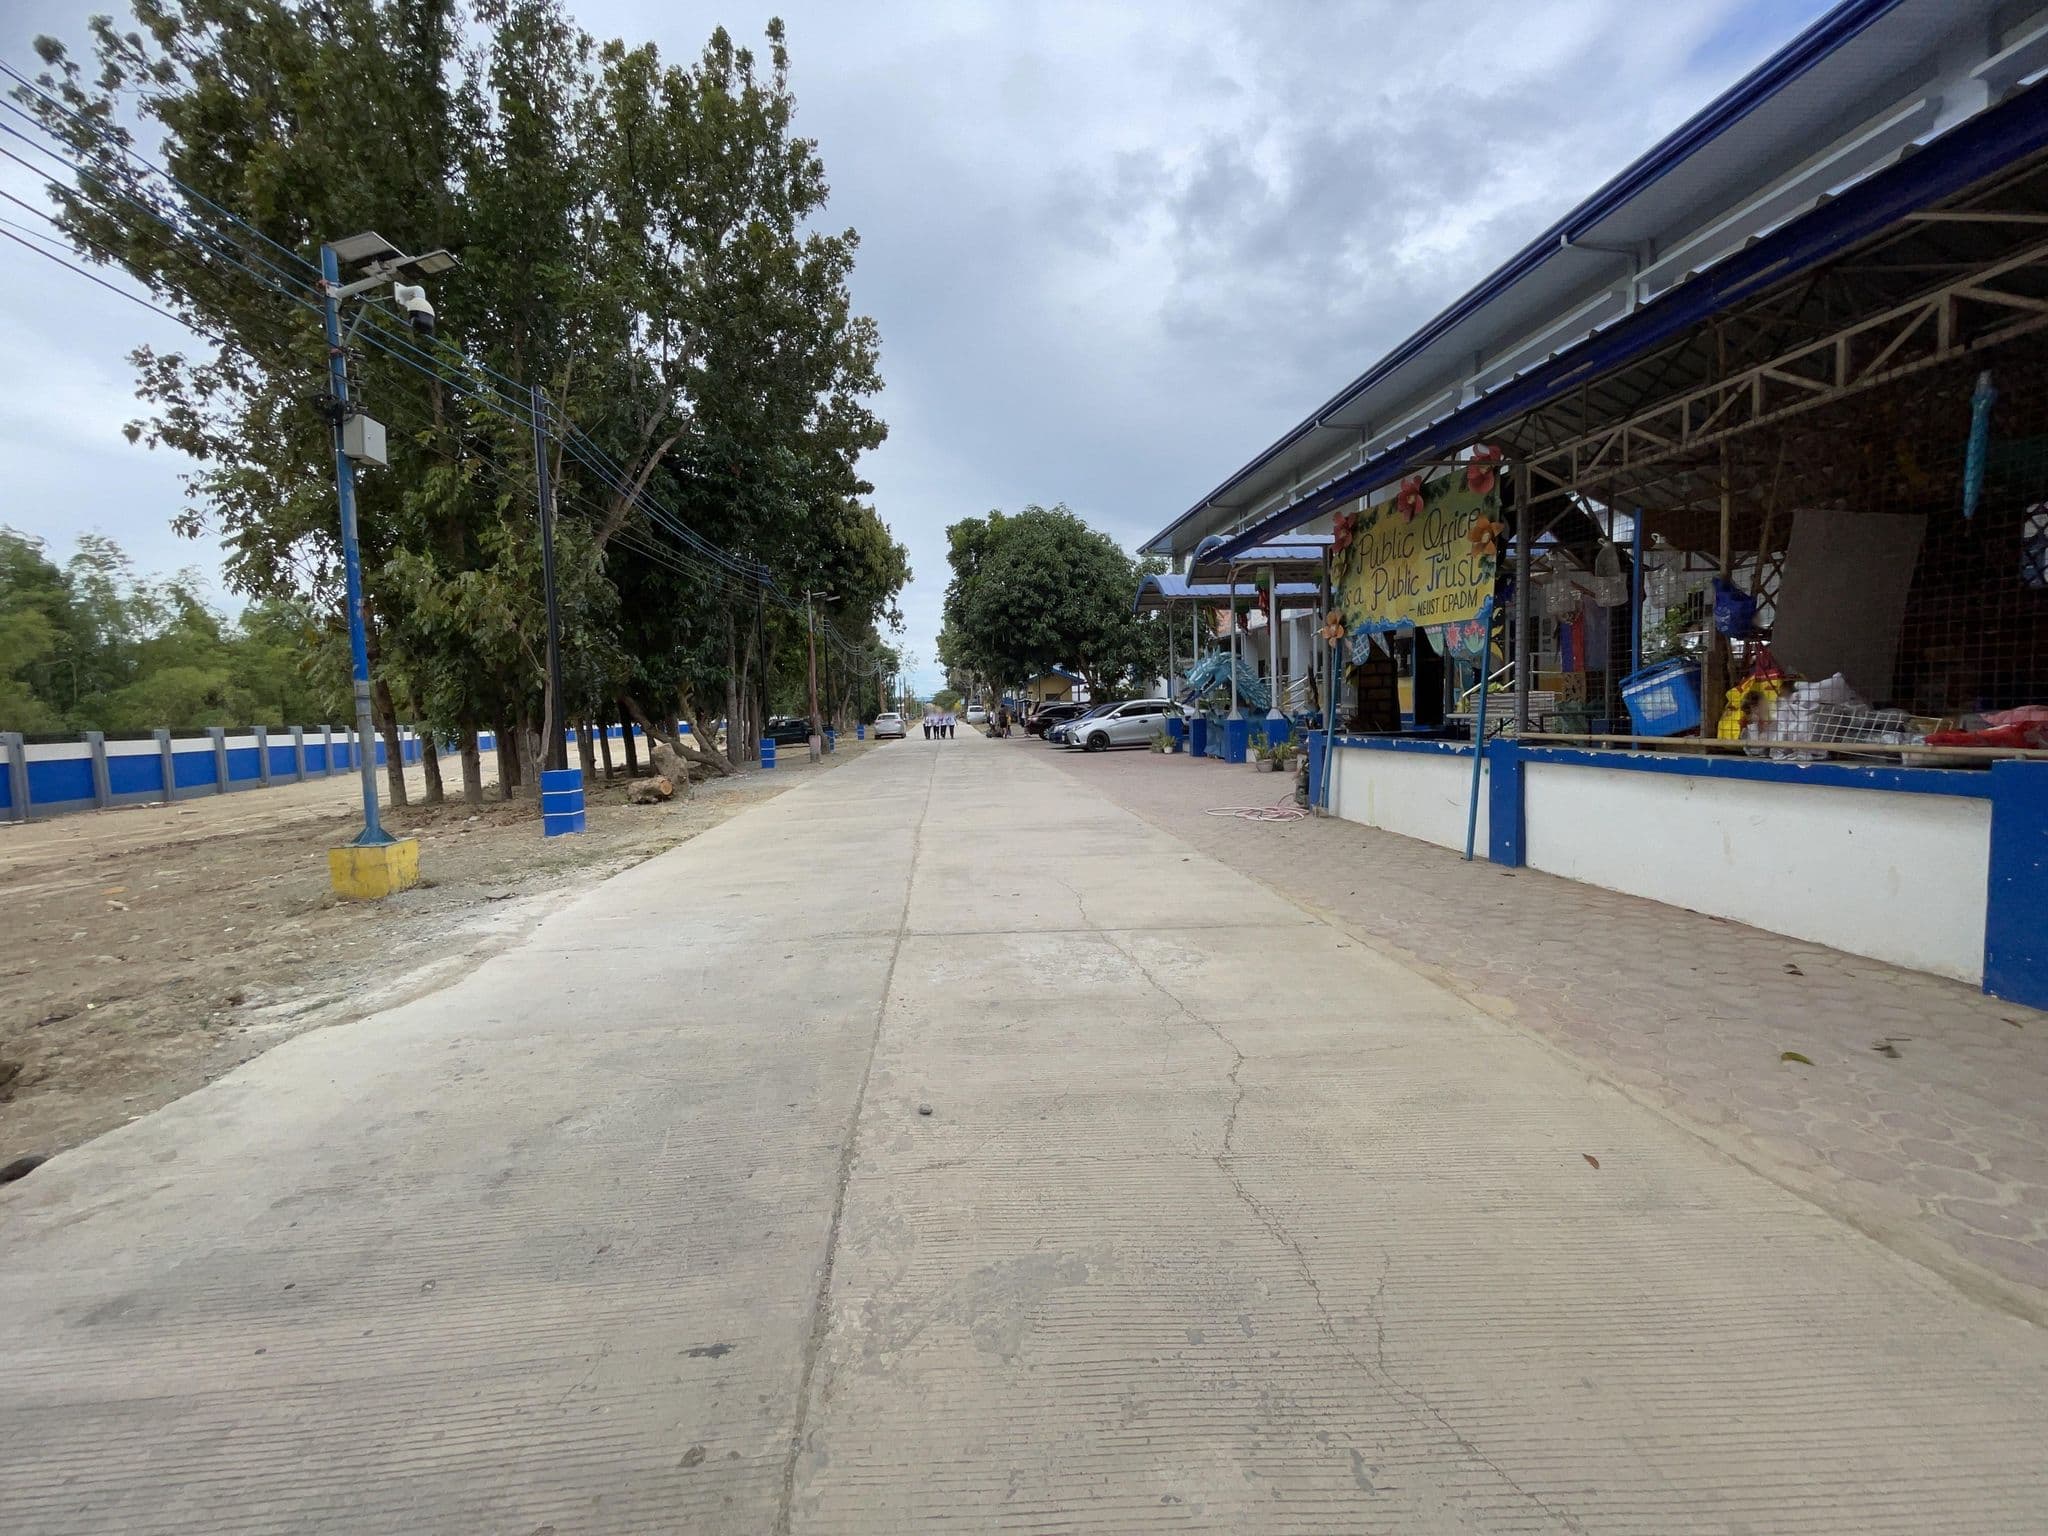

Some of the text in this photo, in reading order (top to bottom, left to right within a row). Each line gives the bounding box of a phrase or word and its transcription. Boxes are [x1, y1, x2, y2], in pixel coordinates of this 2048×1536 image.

[1357, 507, 1481, 574] Public Office
[1354, 587, 1364, 605] a
[1371, 563, 1420, 611] Public
[1443, 588, 1478, 613] CPADM
